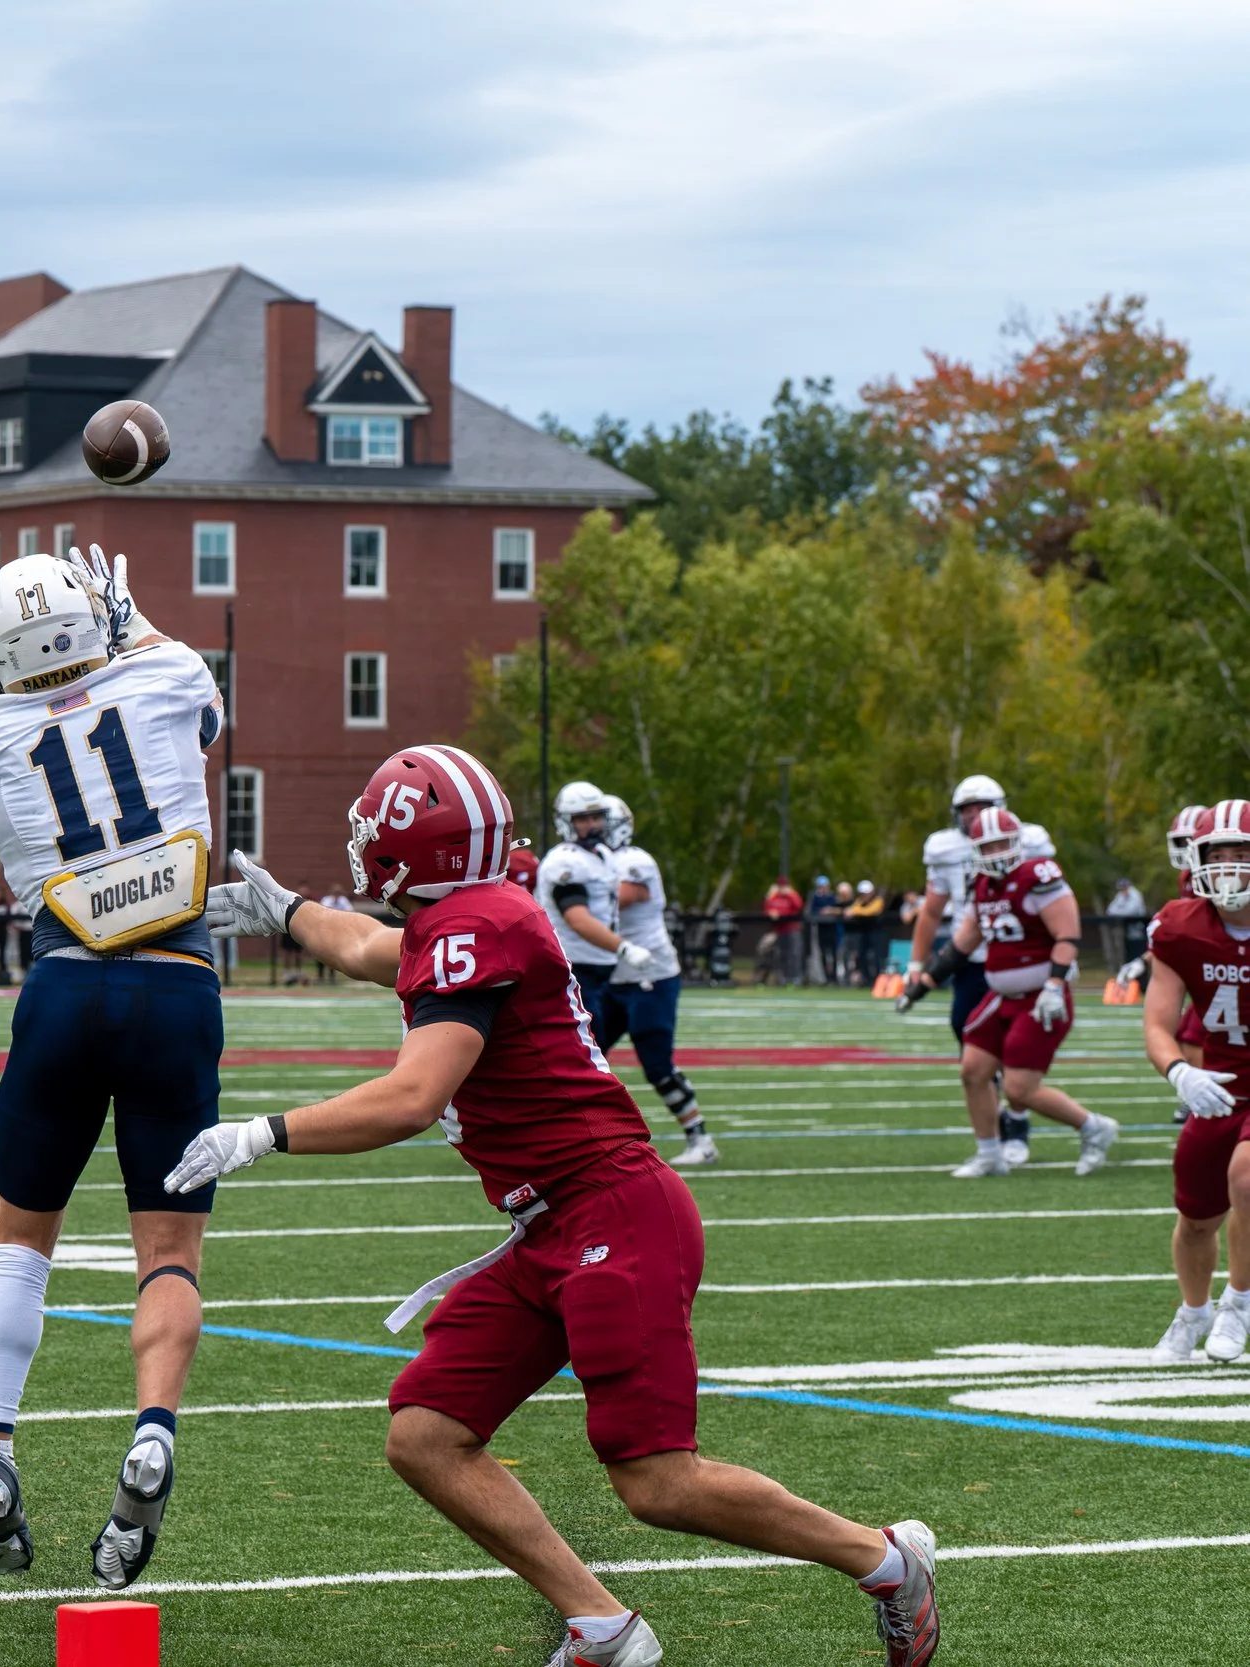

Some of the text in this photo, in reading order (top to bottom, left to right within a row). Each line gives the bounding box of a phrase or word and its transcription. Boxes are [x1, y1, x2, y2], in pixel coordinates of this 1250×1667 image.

[15, 583, 51, 621] 11
[22, 663, 90, 693] BANTAMS
[27, 705, 167, 865] 11
[379, 781, 424, 831] 15
[451, 856, 463, 869] 15
[90, 866, 175, 919] DOUGLAS
[431, 933, 476, 989] 15
